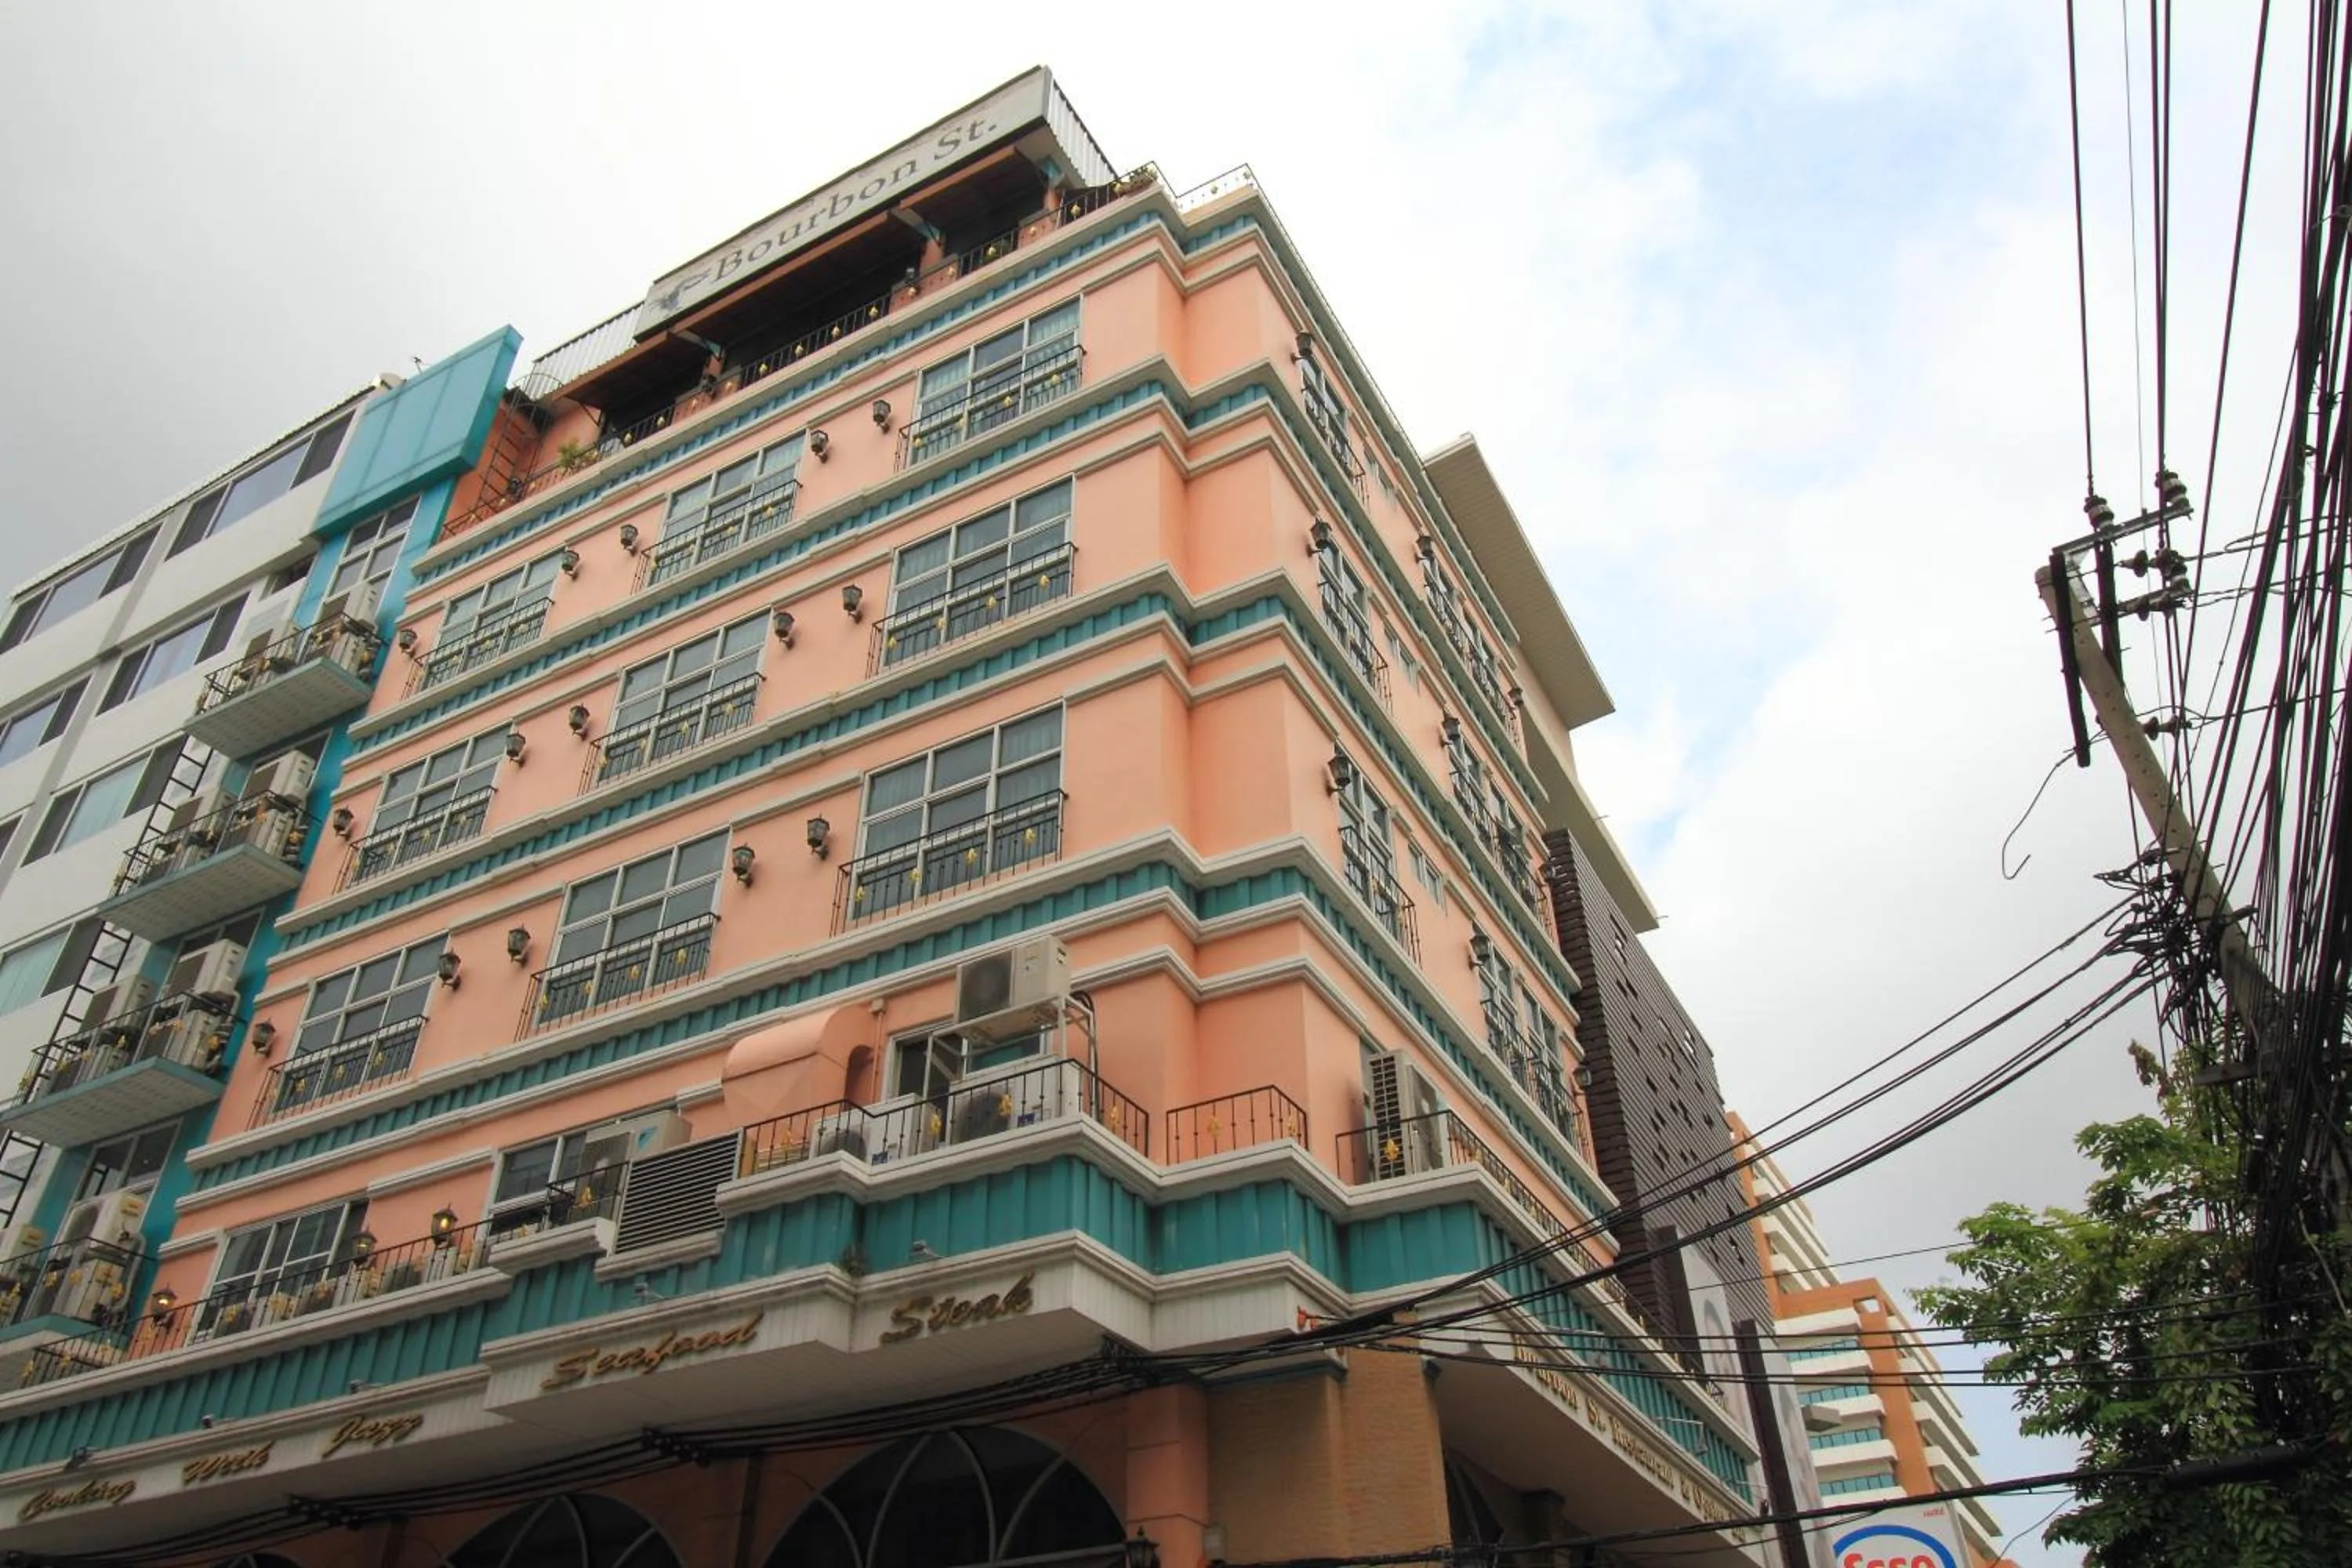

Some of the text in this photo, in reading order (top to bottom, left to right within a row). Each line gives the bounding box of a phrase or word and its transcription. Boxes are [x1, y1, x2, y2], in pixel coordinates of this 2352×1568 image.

[709, 117, 998, 283] Bourbon St.
[539, 1305, 764, 1390] Seafood
[878, 1269, 1036, 1346] Steak
[17, 1479, 136, 1522] Cooking
[183, 1439, 276, 1486] With
